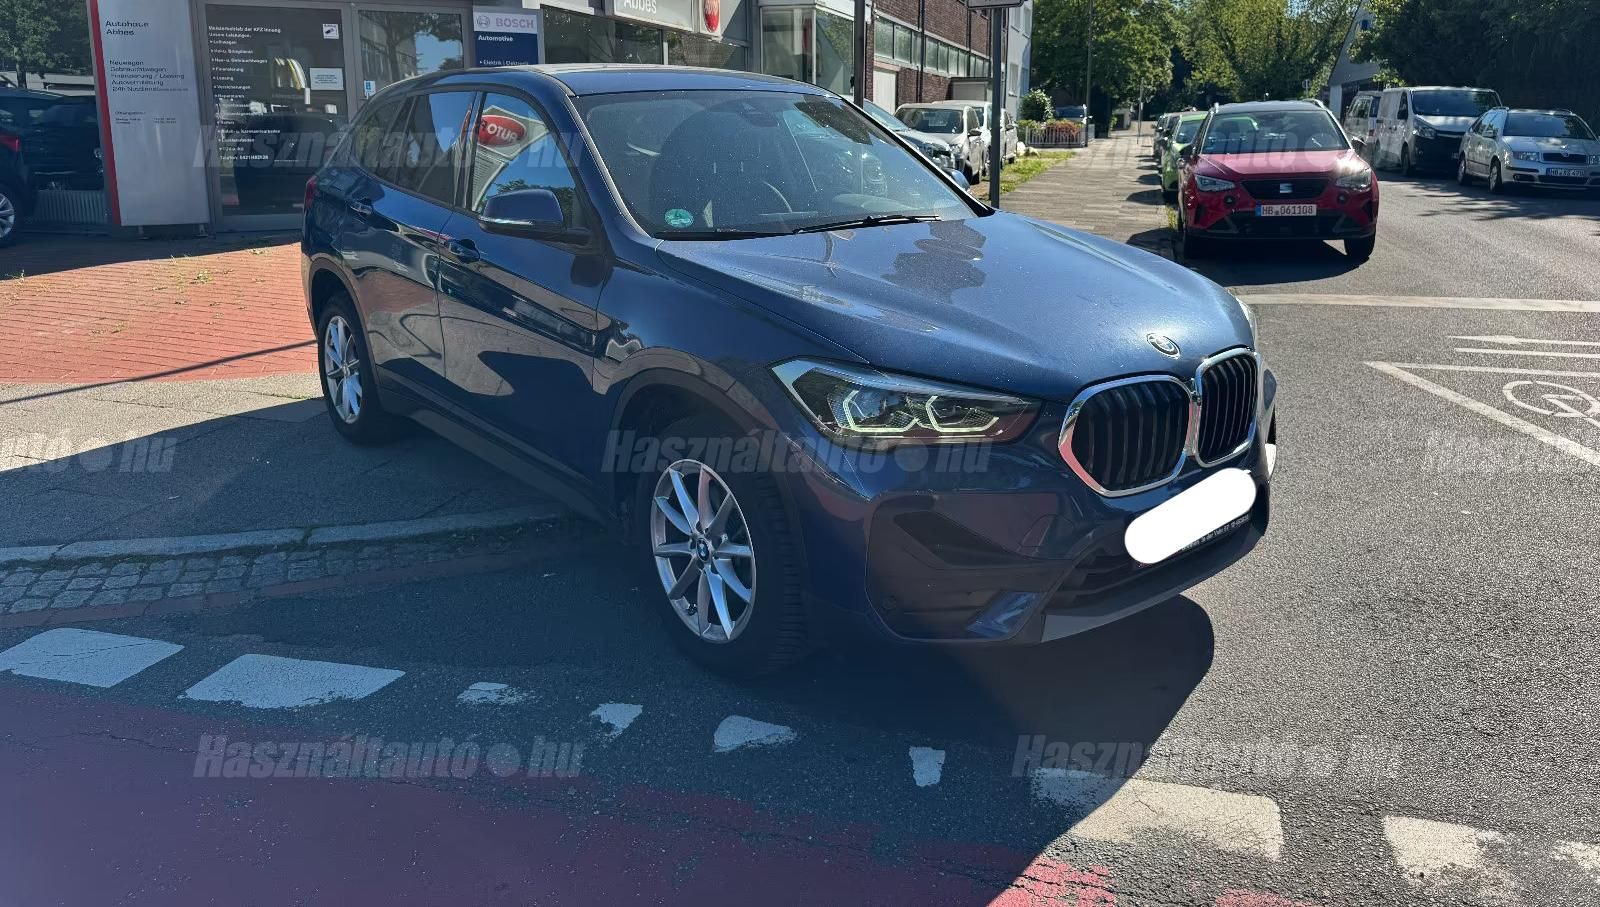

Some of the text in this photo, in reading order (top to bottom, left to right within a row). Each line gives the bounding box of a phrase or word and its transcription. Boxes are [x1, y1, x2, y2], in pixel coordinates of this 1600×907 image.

[495, 17, 534, 28] BOSCH
[106, 28, 135, 36] Abbes
[478, 34, 514, 42] Automotive
